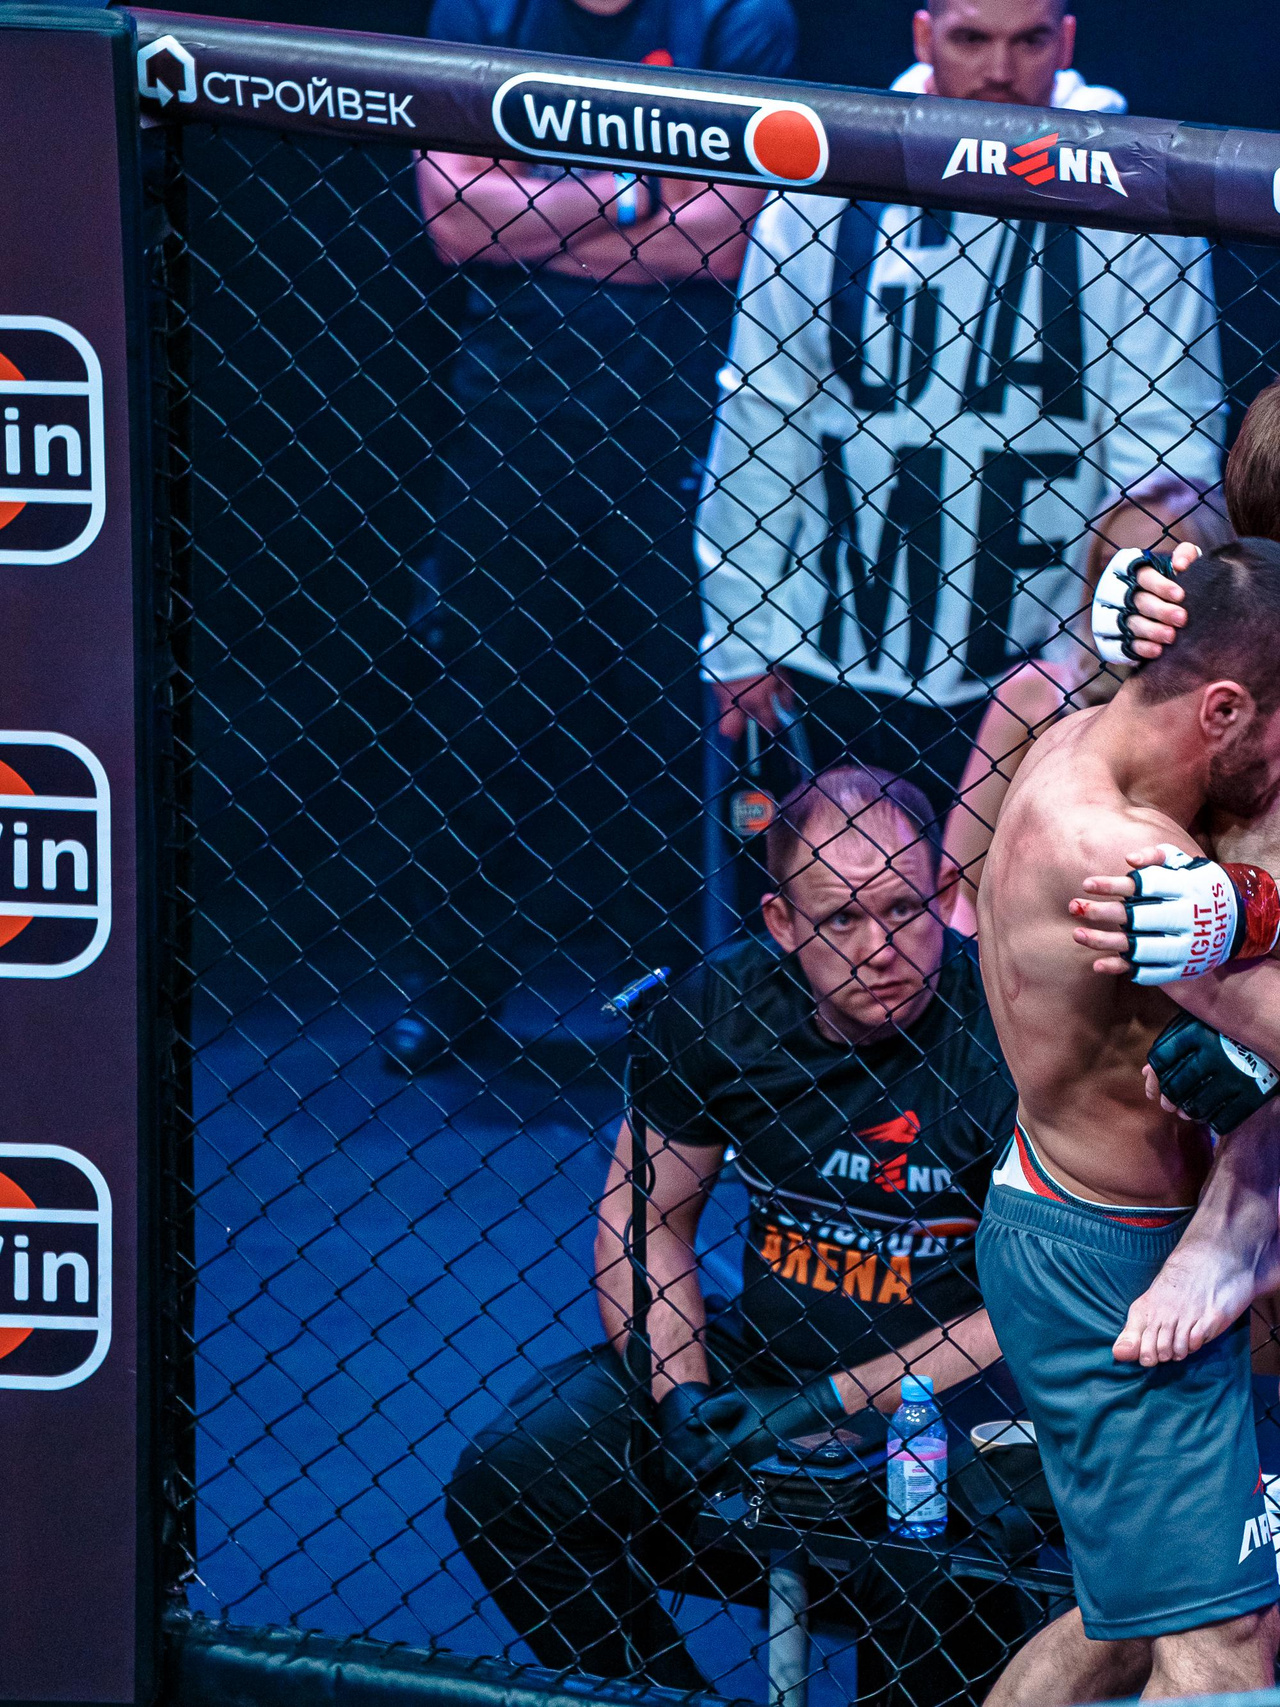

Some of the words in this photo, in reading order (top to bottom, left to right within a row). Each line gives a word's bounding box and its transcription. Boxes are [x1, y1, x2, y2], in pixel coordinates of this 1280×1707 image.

[202, 70, 417, 128] СТРОЙВЕК
[522, 93, 733, 163] Winline
[941, 132, 1129, 198] ARENA
[0, 821, 89, 892] in
[1180, 903, 1213, 978] FIGHT
[816, 1148, 962, 1194] ARENA
[0, 1234, 90, 1304] in
[760, 1223, 914, 1305] ARENA
